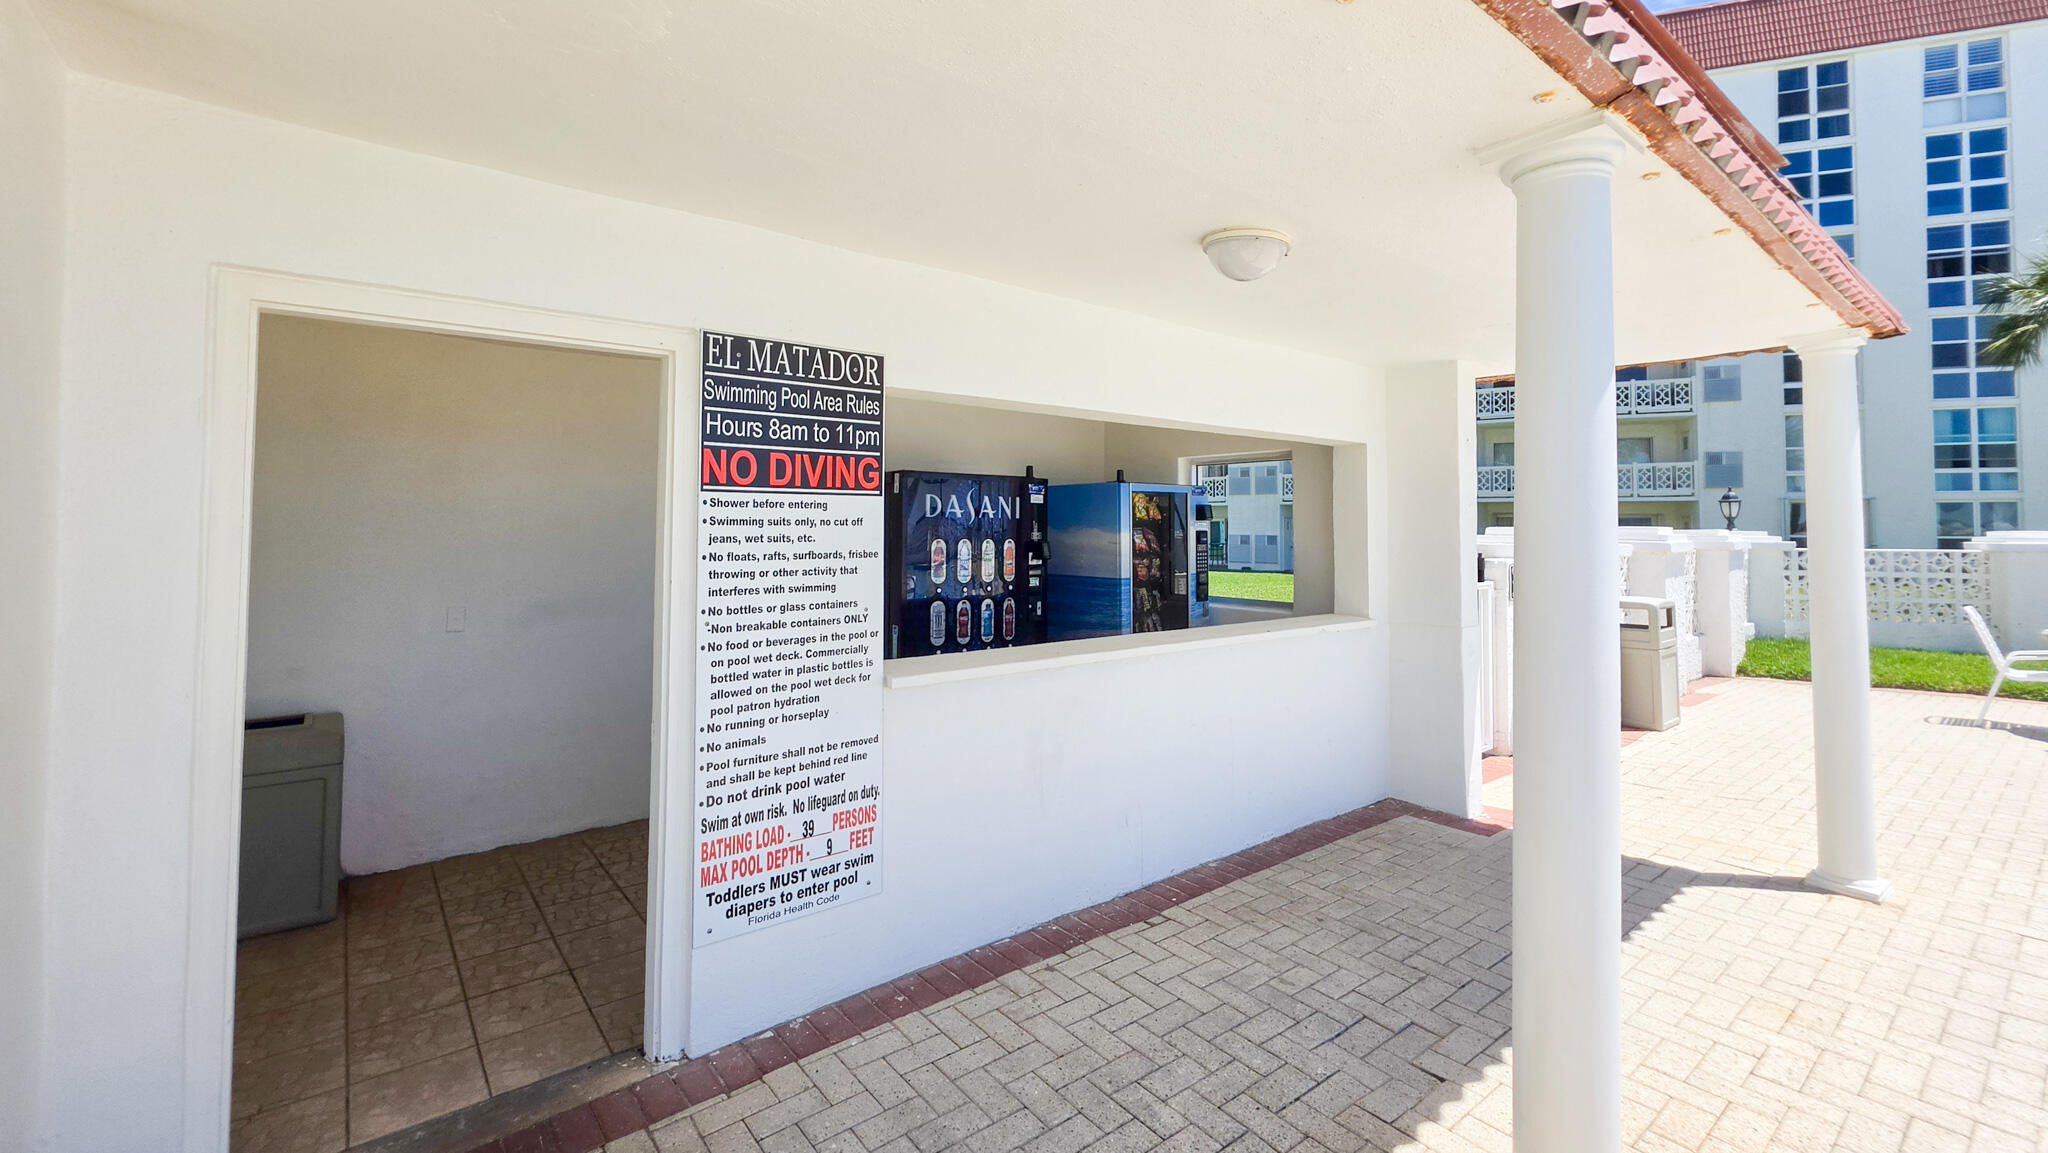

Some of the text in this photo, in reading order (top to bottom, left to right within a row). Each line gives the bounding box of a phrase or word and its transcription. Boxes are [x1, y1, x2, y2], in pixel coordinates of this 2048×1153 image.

[706, 334, 880, 386] EL MATADOR
[704, 379, 880, 415] Swimming Pool Area Rules
[706, 413, 880, 449] Hours 8am to 11pm
[703, 448, 757, 486] NO
[769, 452, 880, 490] DIVING
[709, 498, 827, 511] Shower before entering
[925, 487, 1021, 525] DASANI
[709, 516, 764, 528] Swimming
[767, 517, 791, 526] suits
[795, 518, 817, 528] only,
[834, 518, 848, 526] cut
[852, 517, 863, 526] off
[708, 533, 816, 545] jeans, wet suits, etc.
[709, 549, 879, 562] No floats, rafts, surfboards, frisbee
[708, 565, 858, 580] throwing or other activity that
[708, 583, 836, 597] interferes with swimming
[708, 600, 858, 616] No bottles or glass containers
[736, 620, 787, 632] breakable
[790, 617, 841, 628] containers
[844, 614, 868, 624] ONLY
[707, 642, 722, 652] No
[725, 640, 749, 651] food
[752, 640, 763, 648] or
[766, 636, 816, 649] beverages
[820, 634, 828, 642] in
[831, 632, 846, 641] the
[848, 631, 867, 641] pool
[711, 644, 868, 668] on pool wet deck. Commercially
[710, 658, 873, 684] bottled water in plastic bottles is
[710, 673, 871, 700] allowed on the pool wet deck for
[707, 708, 829, 733] No running or horseplay
[710, 696, 820, 718] pool patron hydration
[706, 734, 879, 772] Pool furniture shall not be removed
[707, 736, 766, 753] No animals
[706, 752, 868, 788] and shall be kept behind red line
[706, 771, 846, 808] Do not drink pool water
[701, 785, 880, 834] Swim at own risk. No lifeguard on duty.
[701, 832, 752, 862] BATHING
[756, 825, 784, 849] LOAD
[802, 820, 814, 838] 39
[832, 804, 877, 831] PERSONS
[700, 862, 727, 888] MAX
[732, 853, 763, 880] POOL
[767, 844, 804, 871] DEPTH
[827, 839, 832, 855] 9
[849, 827, 874, 850] FEET
[706, 853, 873, 906] Toddlers MUST wear swim
[726, 871, 858, 919] diapers to enter pool
[748, 894, 840, 926] Florida Health Code
